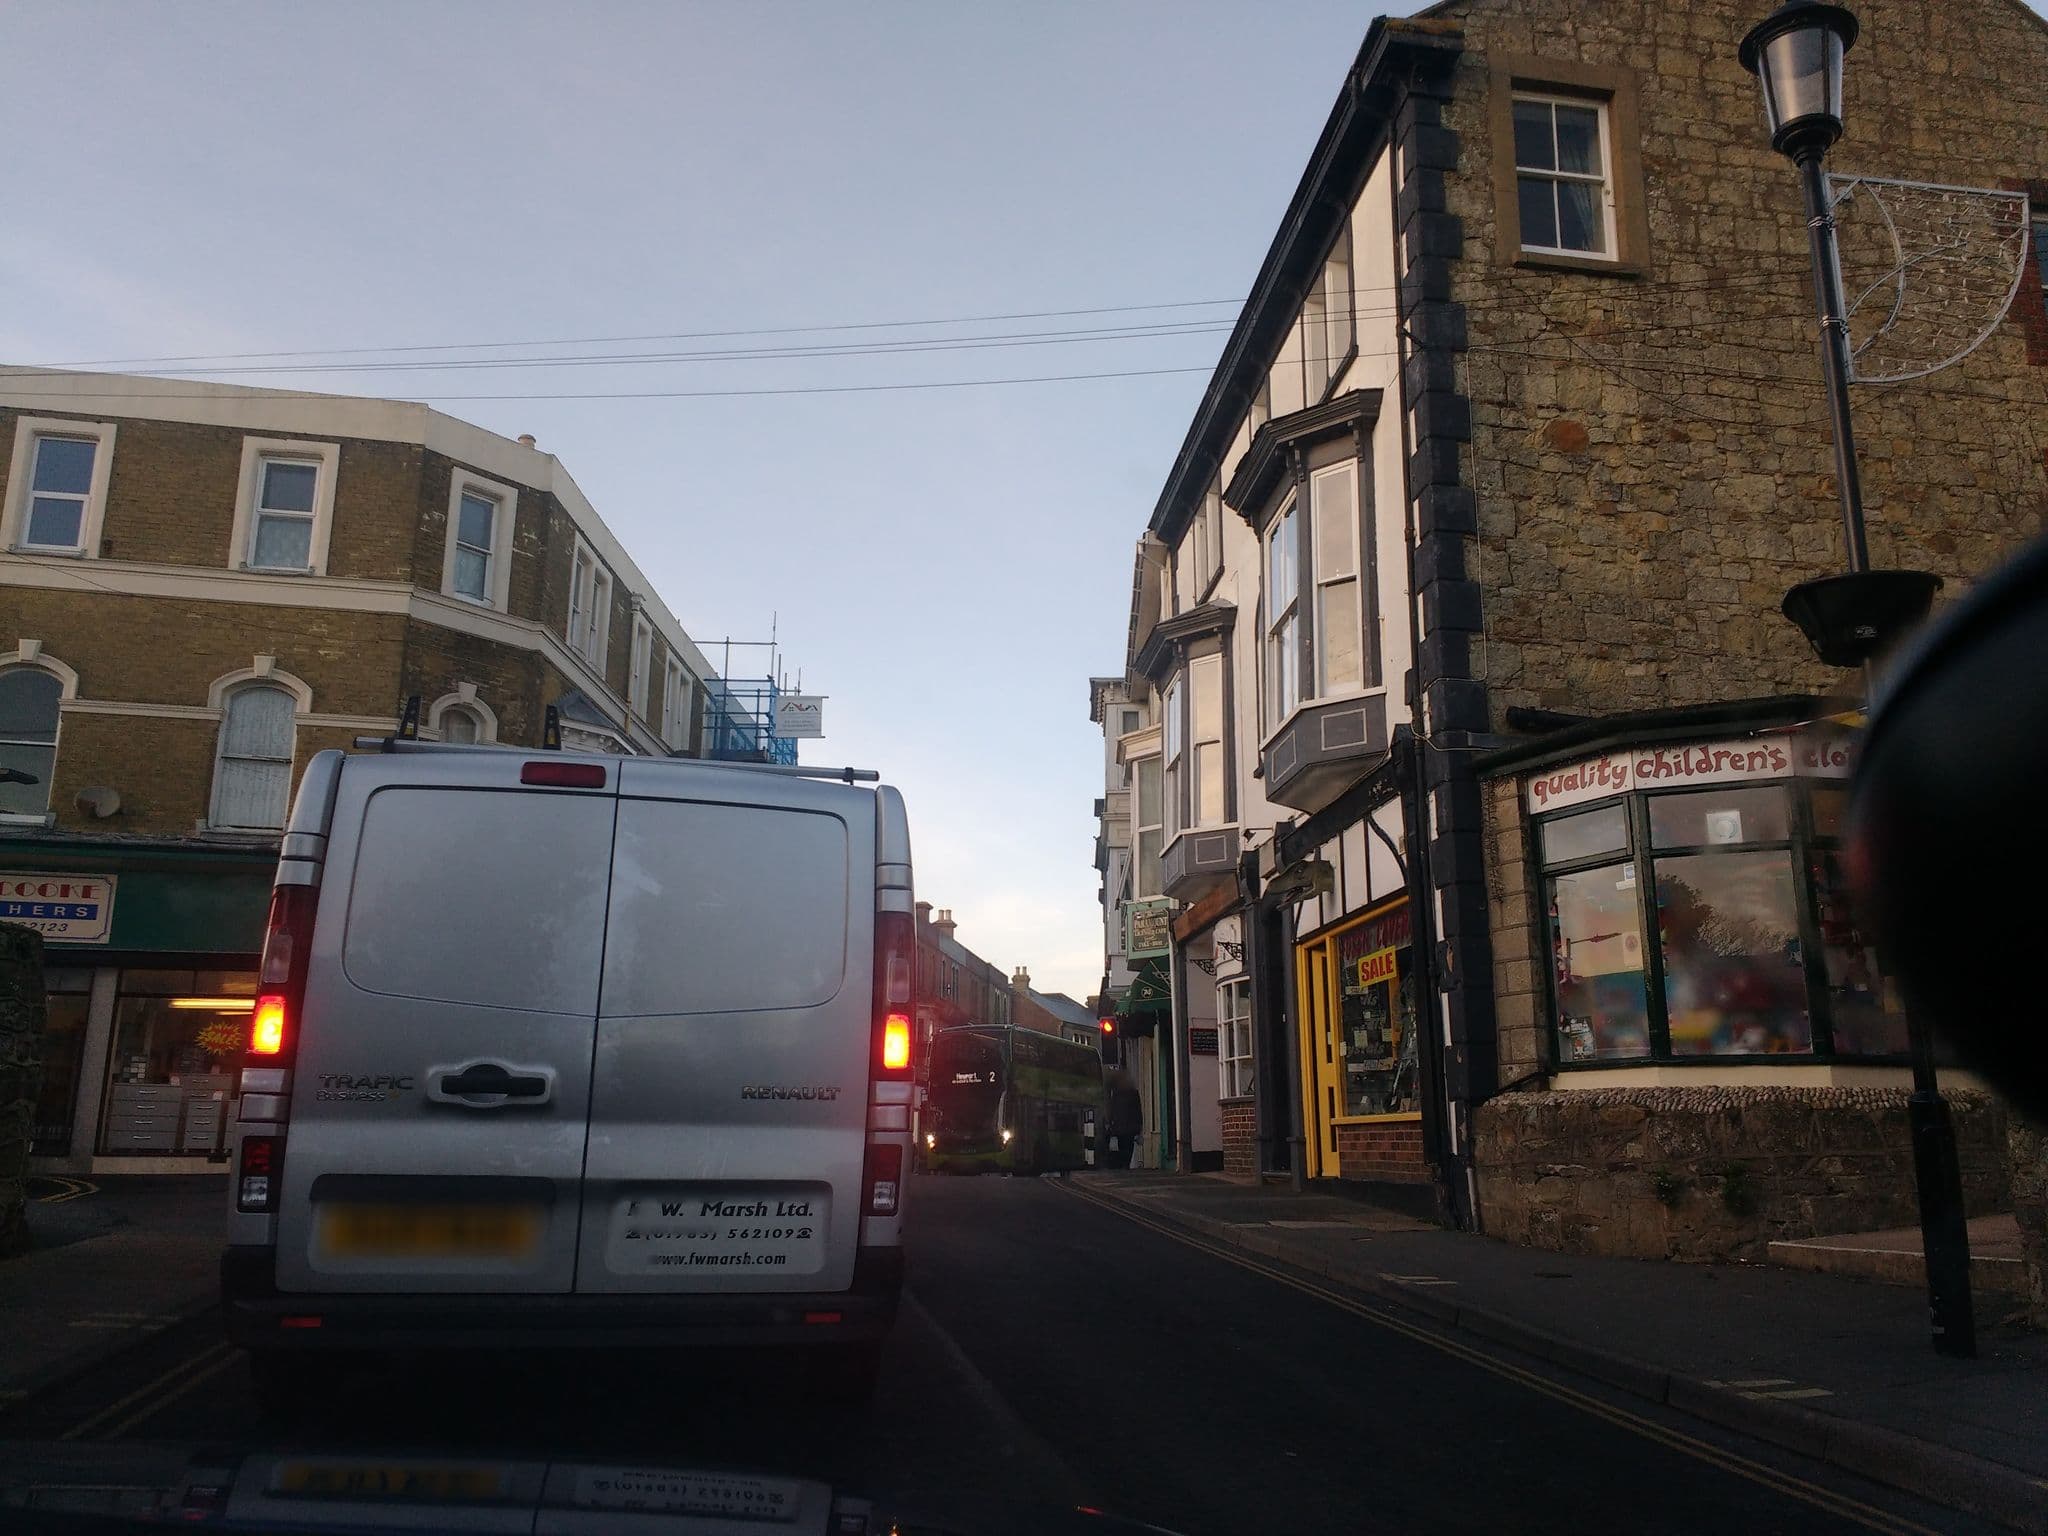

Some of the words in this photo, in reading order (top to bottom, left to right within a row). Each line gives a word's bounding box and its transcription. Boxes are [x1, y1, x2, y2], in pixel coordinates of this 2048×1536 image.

[1533, 757, 1628, 806] quality
[1634, 744, 1788, 781] children's
[1361, 952, 1394, 982] SALE
[319, 1073, 414, 1089] TRAFIC
[989, 1070, 996, 1082] 2
[741, 1085, 842, 1101] RENAULT
[661, 1200, 684, 1217] W.
[700, 1200, 769, 1217] Marsh
[775, 1200, 814, 1217] Ltd.
[727, 1228, 794, 1240] 562109
